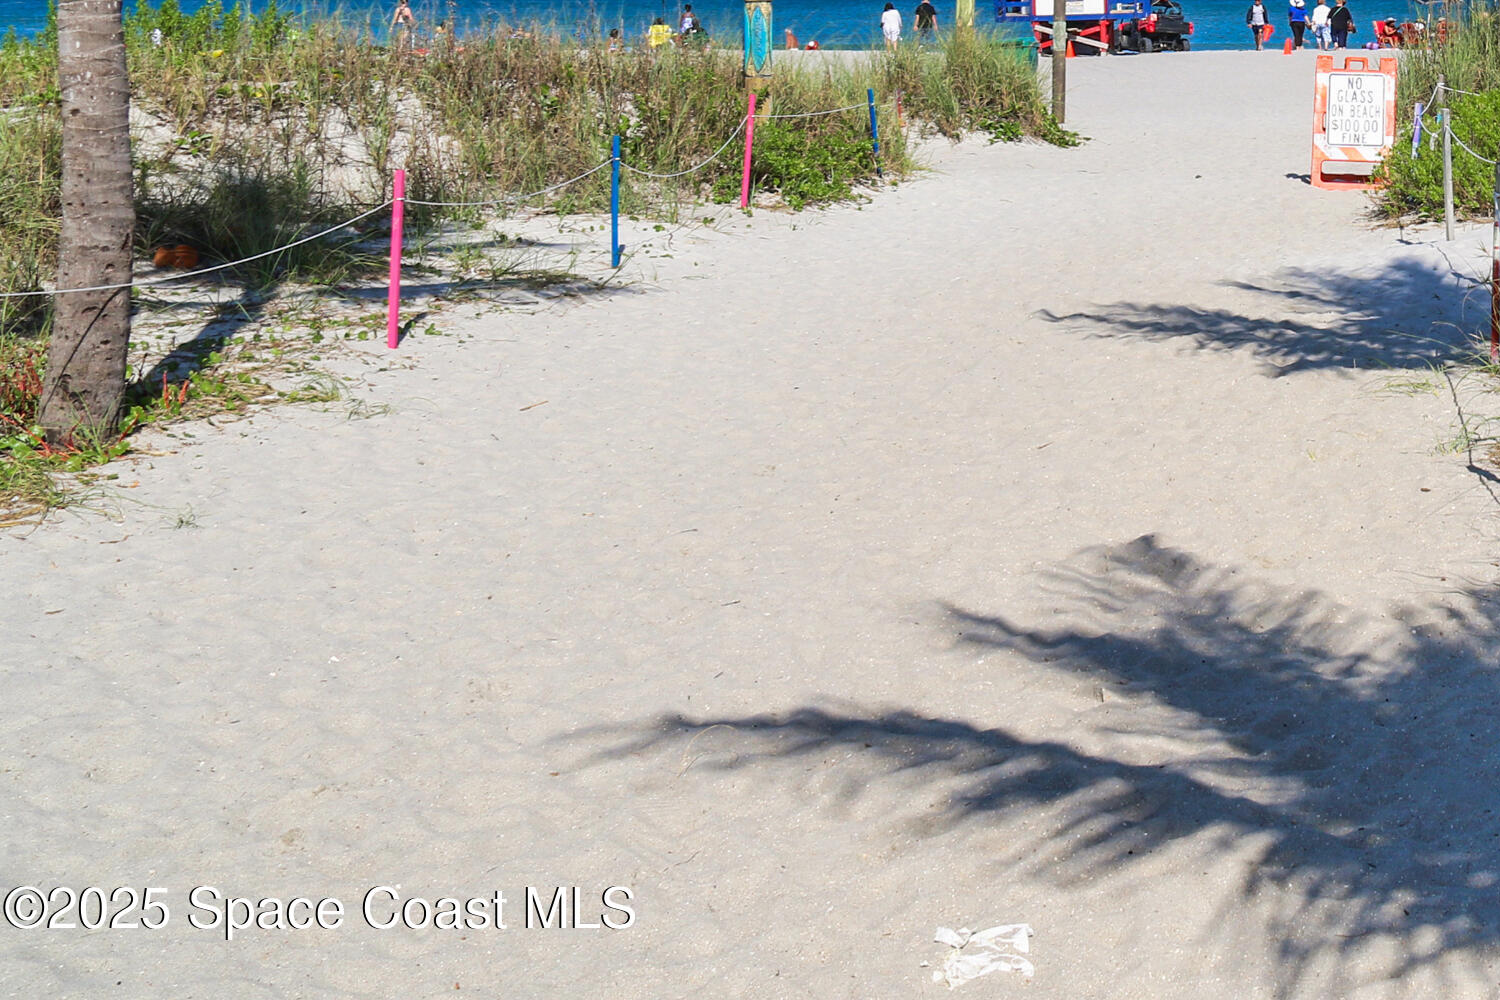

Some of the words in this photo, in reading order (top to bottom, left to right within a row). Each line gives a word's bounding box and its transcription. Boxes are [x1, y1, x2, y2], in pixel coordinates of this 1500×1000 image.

[1347, 77, 1363, 90] NO
[1337, 89, 1374, 104] GLASS
[1331, 104, 1344, 117] ON
[1350, 105, 1381, 118] BEACH
[1342, 132, 1368, 144] FINE
